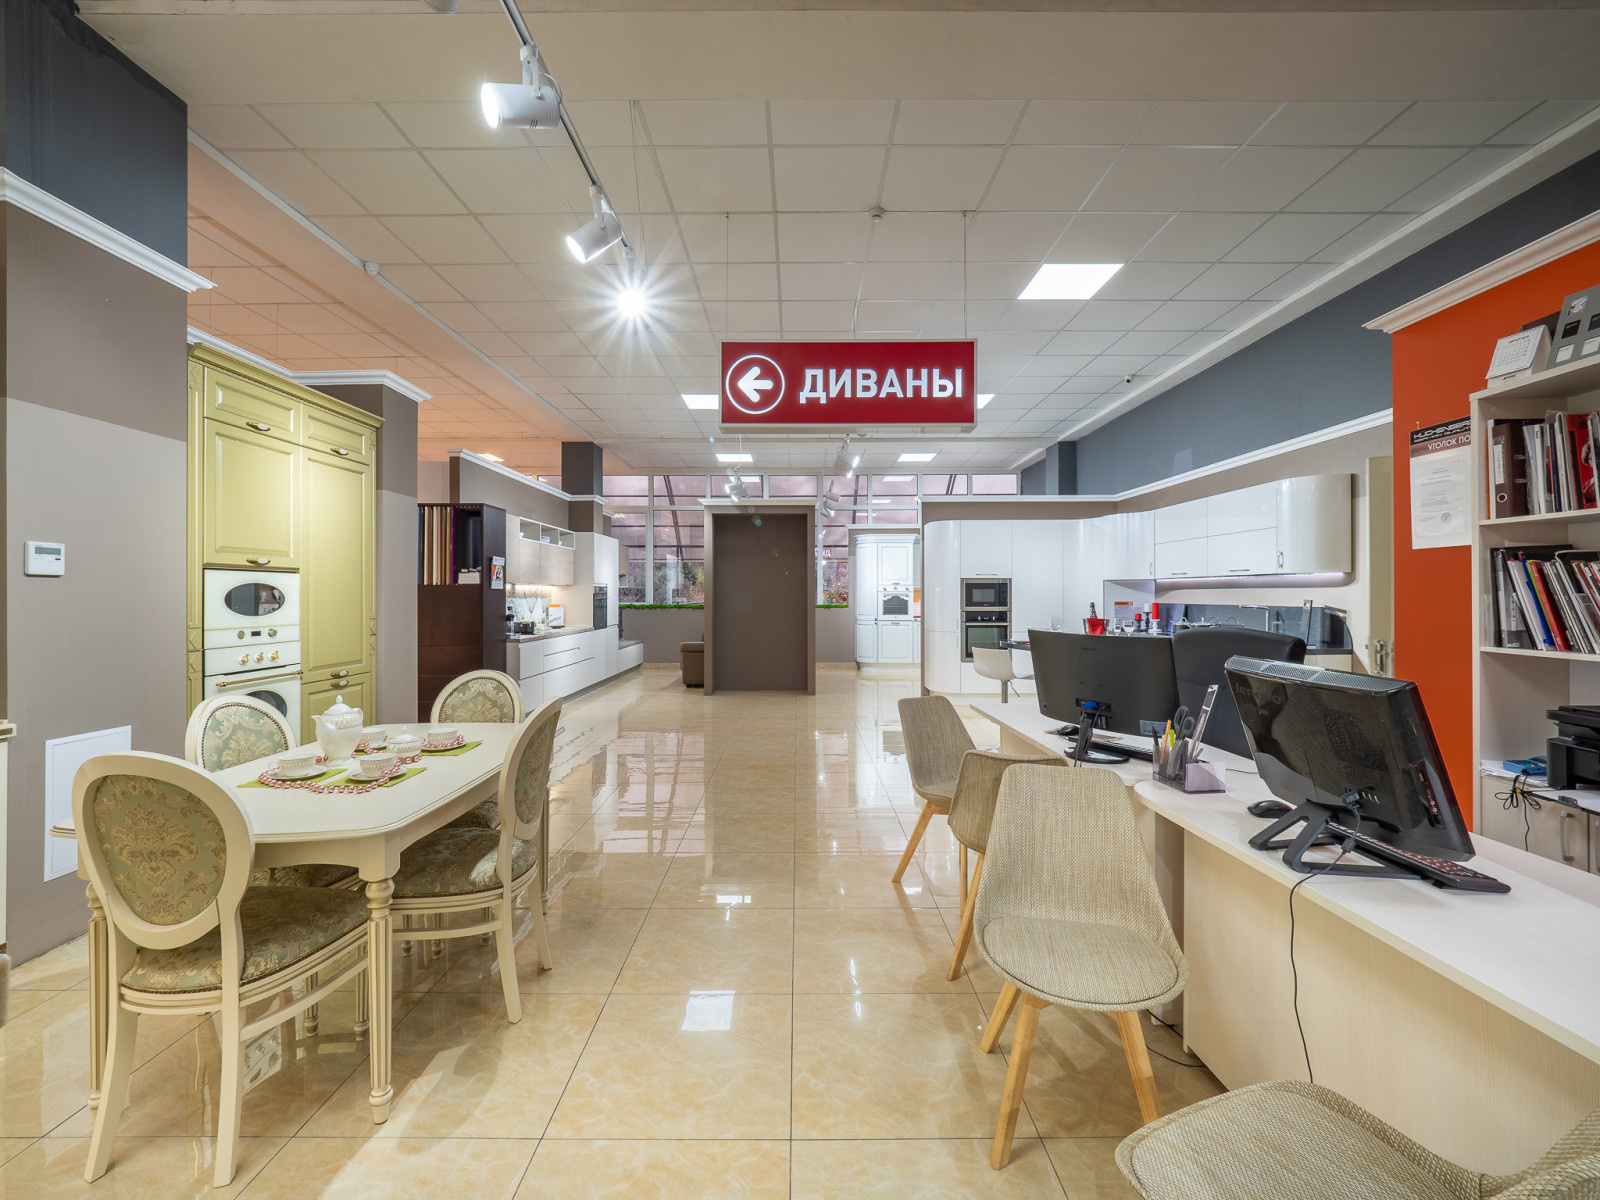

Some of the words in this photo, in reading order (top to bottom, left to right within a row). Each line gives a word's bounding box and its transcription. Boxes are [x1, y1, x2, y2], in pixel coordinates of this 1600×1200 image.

[799, 368, 962, 404] ДИВАНЫ
[1427, 437, 1458, 450] УГОЛОК
[1458, 434, 1472, 444] ПО
[1235, 682, 1282, 705] leno
